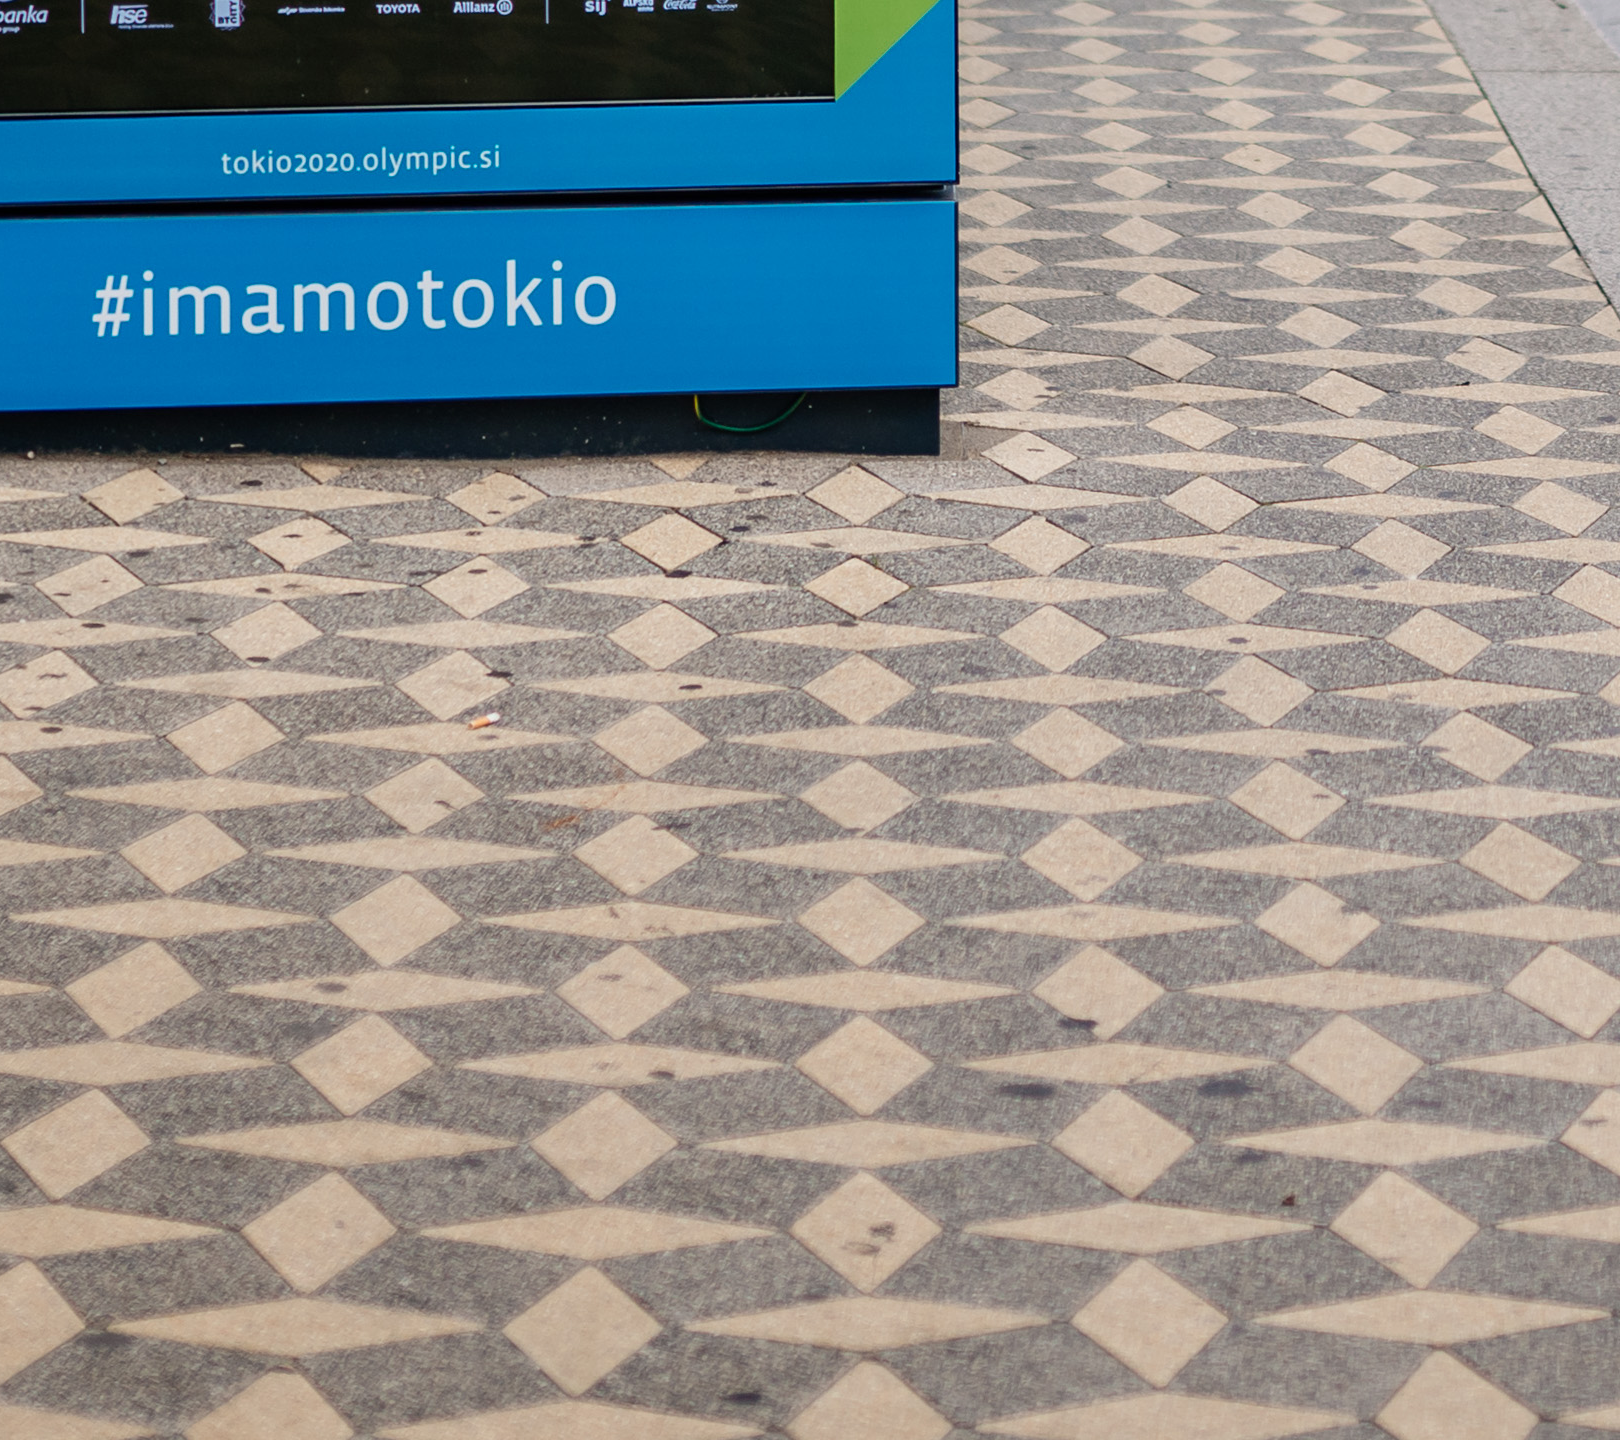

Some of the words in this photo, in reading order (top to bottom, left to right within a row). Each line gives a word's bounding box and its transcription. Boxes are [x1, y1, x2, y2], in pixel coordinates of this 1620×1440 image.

[110, 4, 149, 25] hse
[376, 3, 421, 14] TOYOTA
[453, 1, 496, 14] Allianz
[221, 145, 500, 178] tokio2020.olympic.si
[92, 259, 617, 338] #imamotokio
